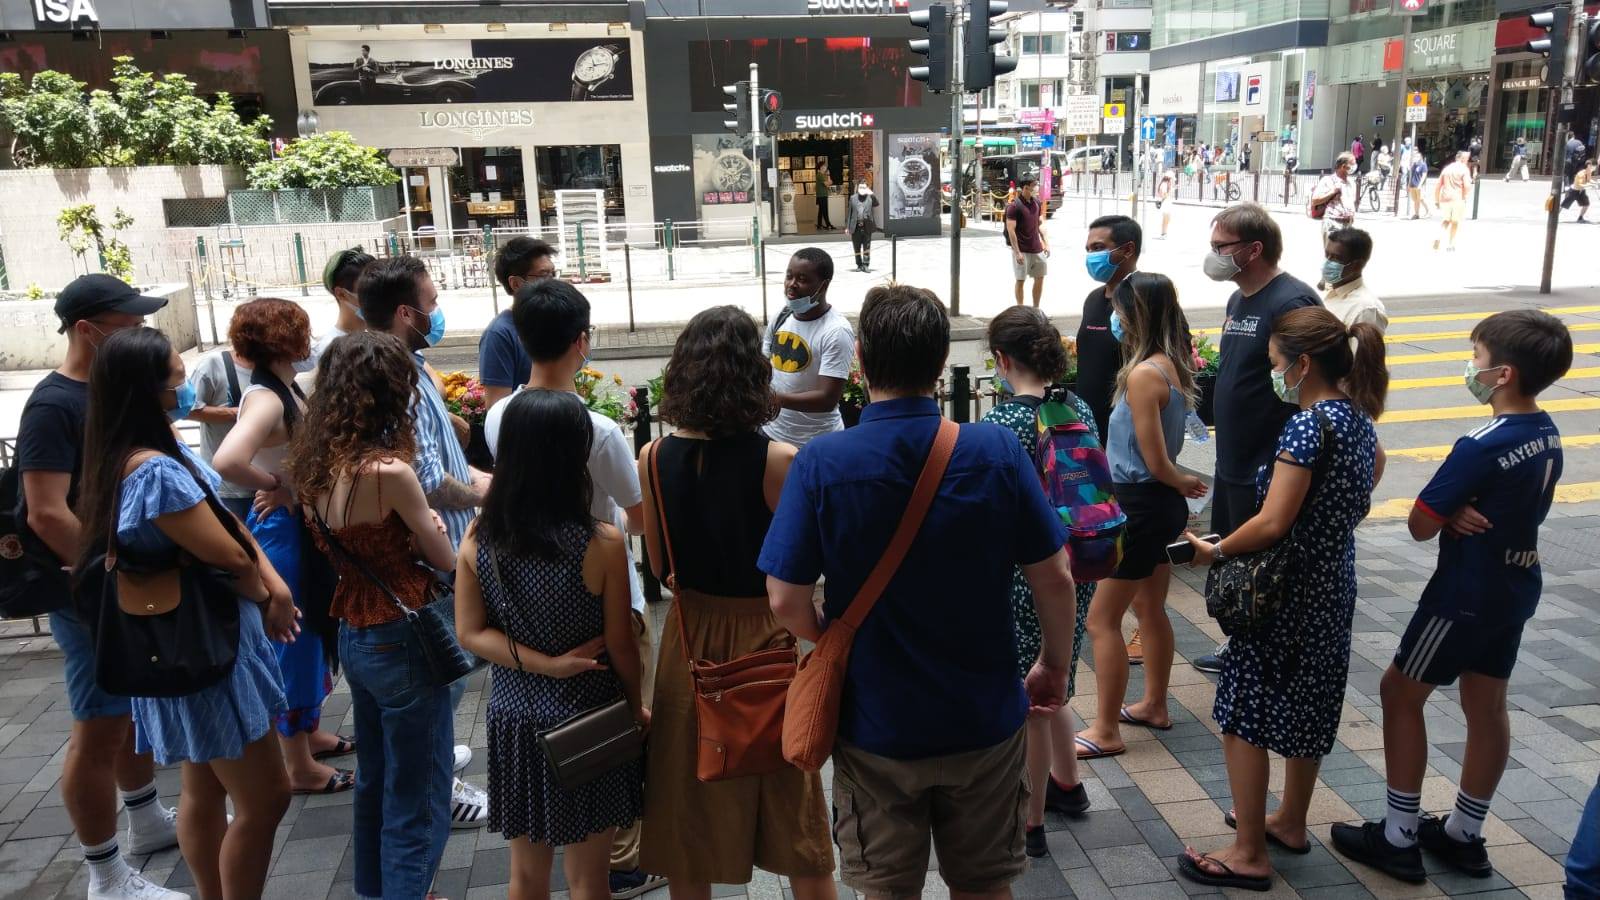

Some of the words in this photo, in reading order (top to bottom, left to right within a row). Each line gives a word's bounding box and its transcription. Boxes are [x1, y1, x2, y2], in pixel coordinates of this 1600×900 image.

[35, 0, 98, 22] ISA
[1413, 34, 1457, 56] SQUARE
[433, 56, 514, 70] LONGINES
[419, 109, 534, 128] LONGINES
[795, 112, 862, 129] swatch
[1498, 439, 1545, 470] BAYERN
